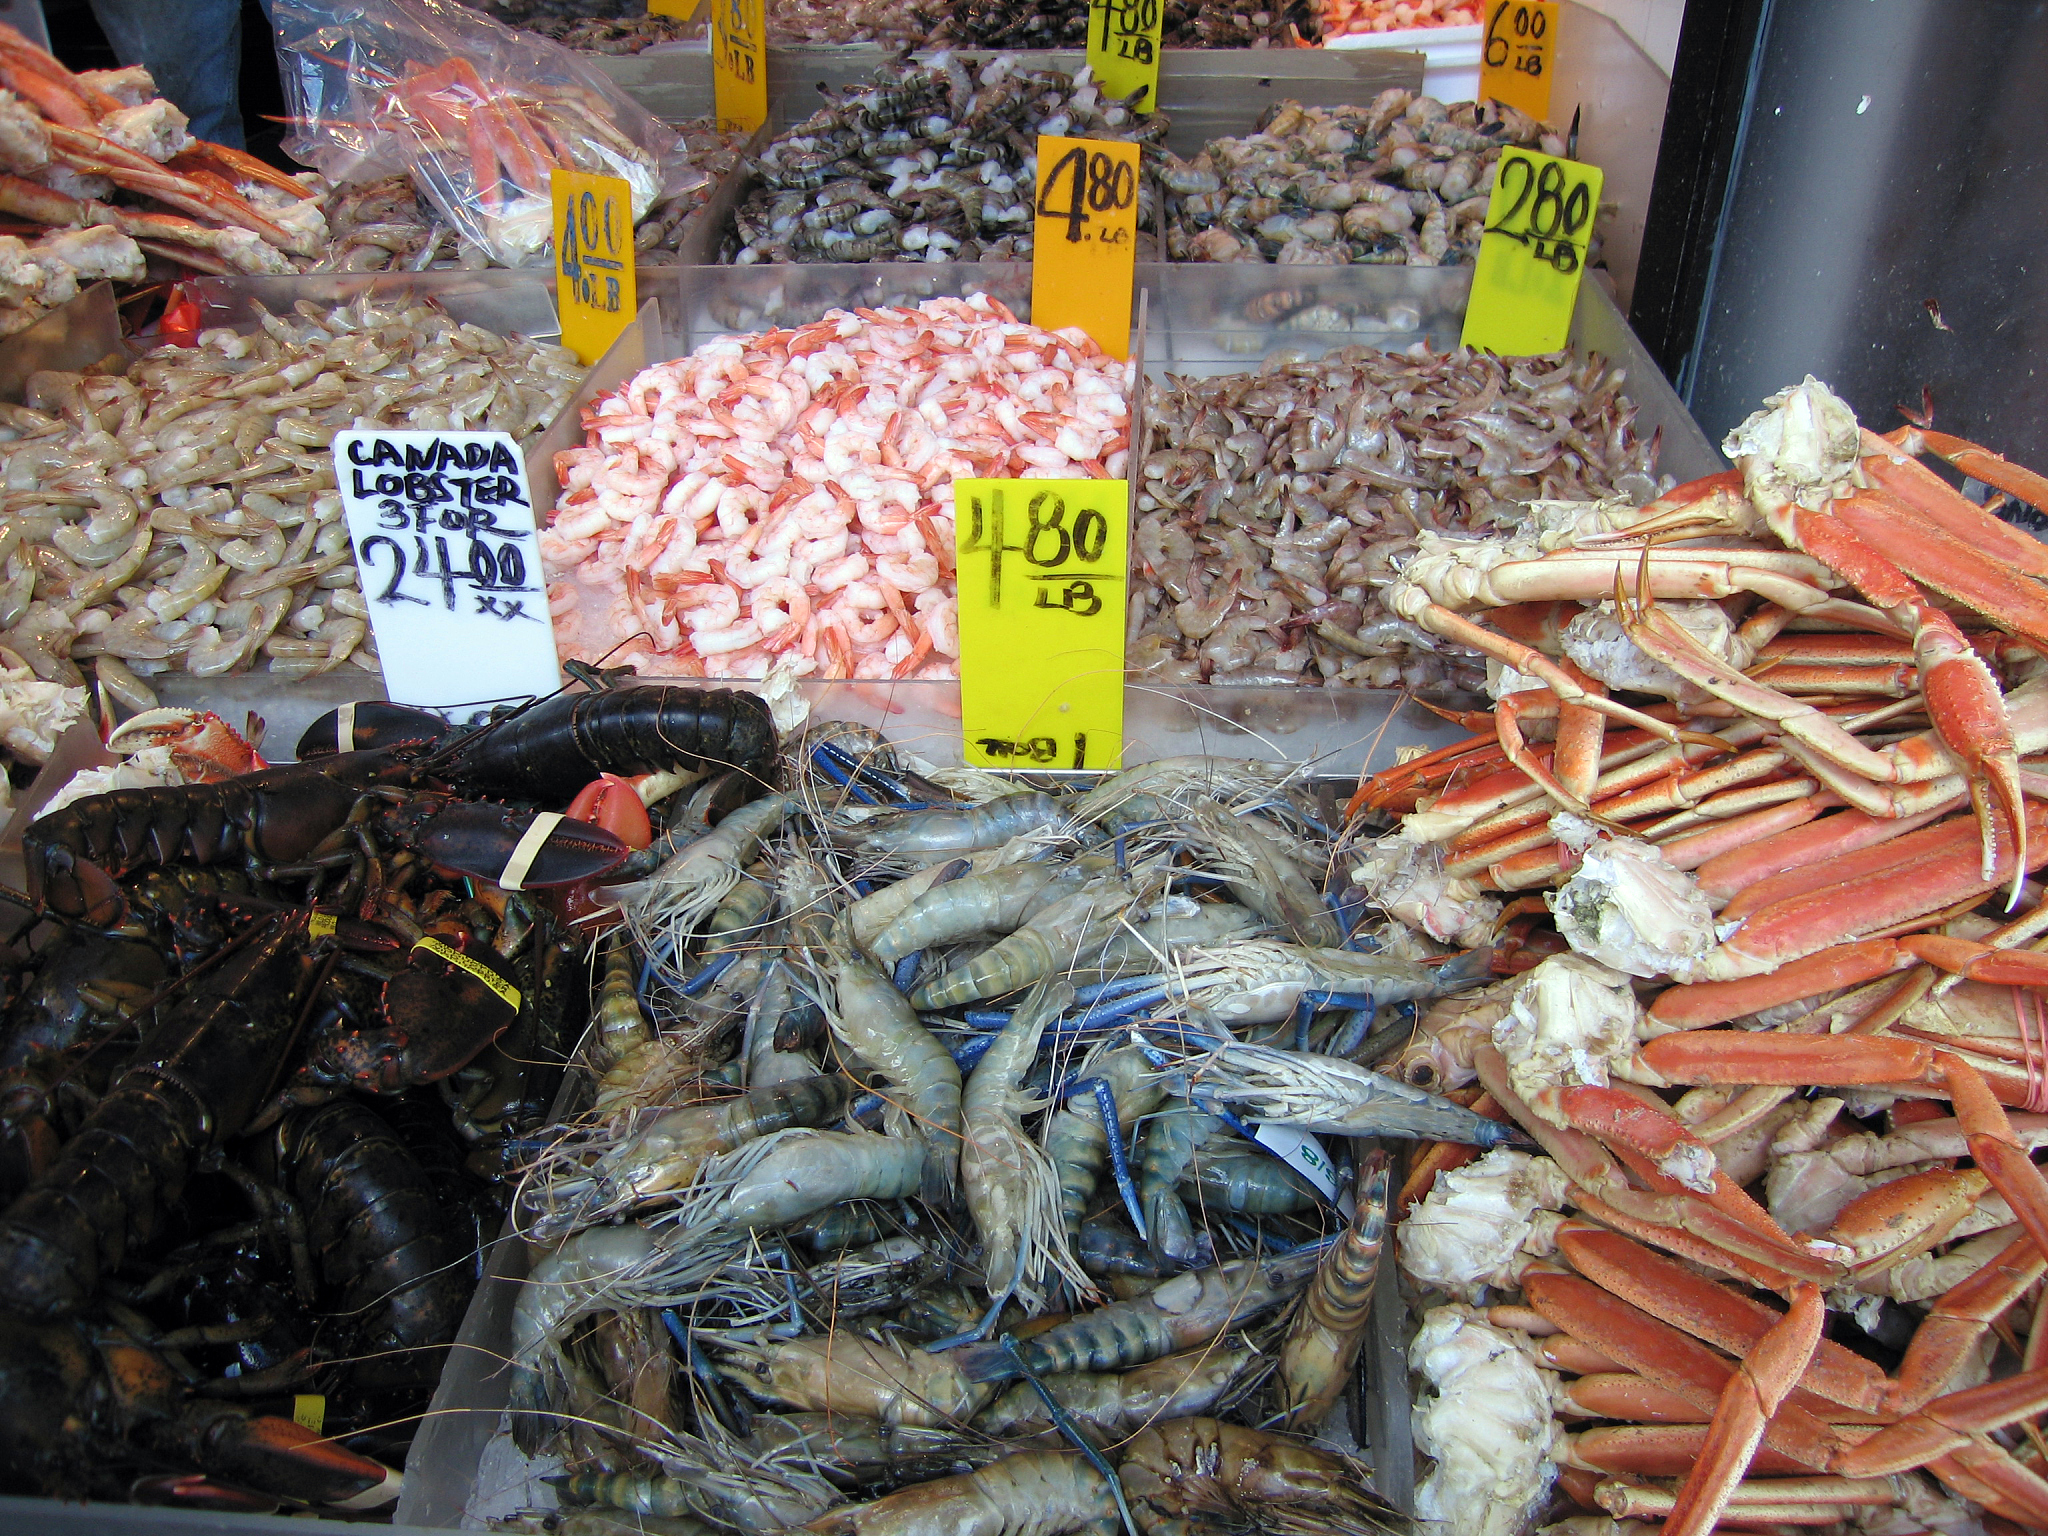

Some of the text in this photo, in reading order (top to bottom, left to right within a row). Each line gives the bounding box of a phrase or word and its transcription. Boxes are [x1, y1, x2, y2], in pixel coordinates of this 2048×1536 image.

[1117, 36, 1153, 65] LB
[1514, 55, 1543, 77] LB
[1533, 239, 1579, 276] LB
[347, 437, 519, 475] CANADA
[352, 468, 531, 509] LOBSTER
[376, 498, 410, 530] 3
[1033, 580, 1103, 617] LB
